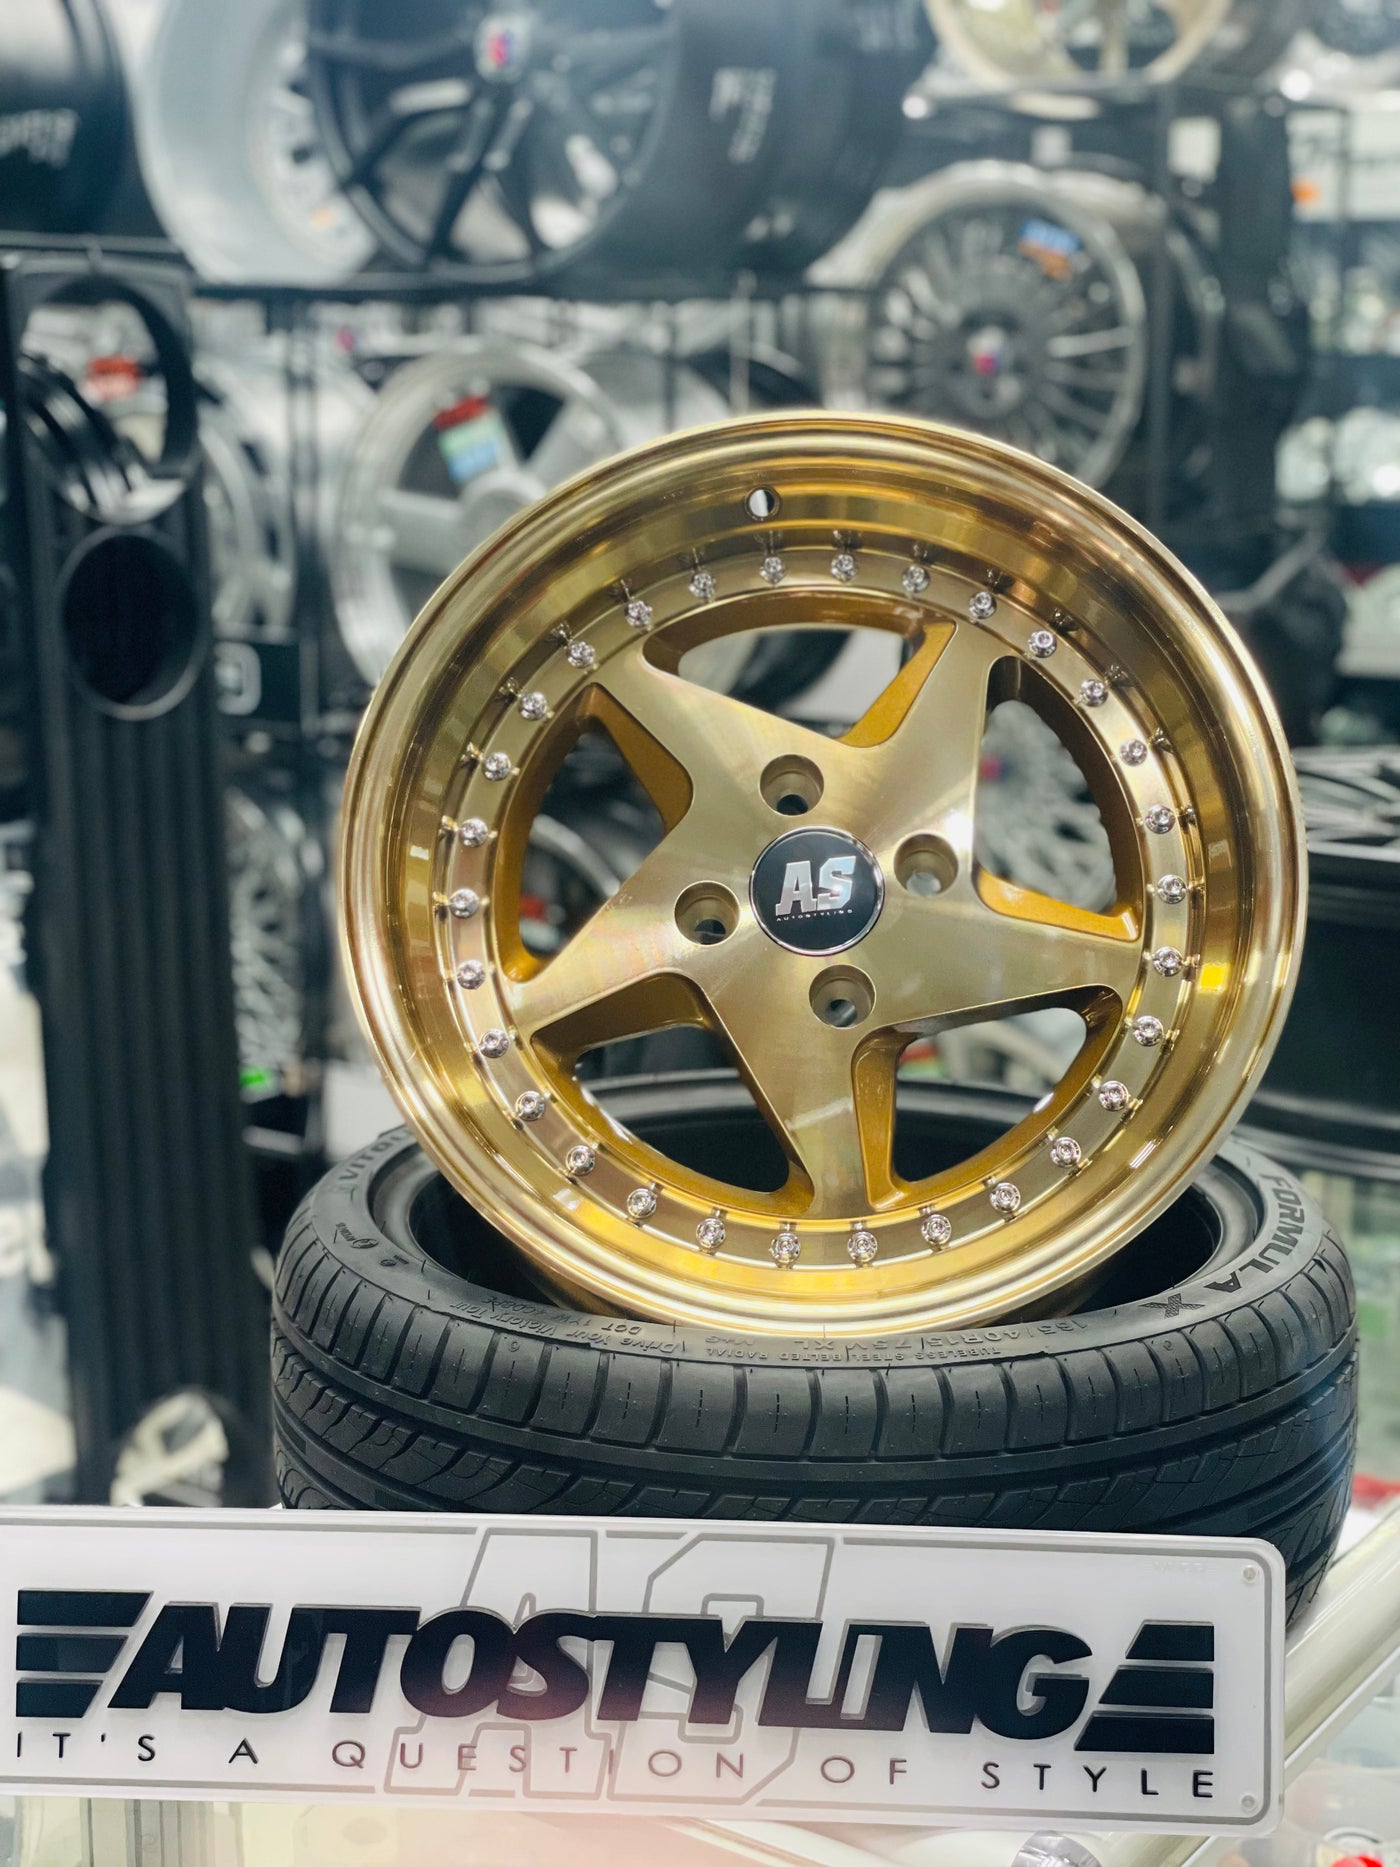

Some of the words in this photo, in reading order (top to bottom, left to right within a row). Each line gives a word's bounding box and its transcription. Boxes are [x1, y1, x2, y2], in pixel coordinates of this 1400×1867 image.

[775, 855, 857, 917] AS
[1203, 1172, 1306, 1294] FORMULA
[449, 1301, 488, 1319] Tour
[1138, 1292, 1206, 1319] X
[489, 1312, 556, 1337] Victory
[566, 1329, 609, 1346] Your
[601, 1322, 642, 1336] DOT
[620, 1337, 679, 1354] Drive
[107, 1601, 1093, 1740] AUTOSTYLING
[16, 1731, 156, 1762] IT'S
[228, 1737, 258, 1764] A
[332, 1740, 745, 1779] QUESTION
[820, 1755, 907, 1785] OF
[982, 1762, 1214, 1799] STYLE
